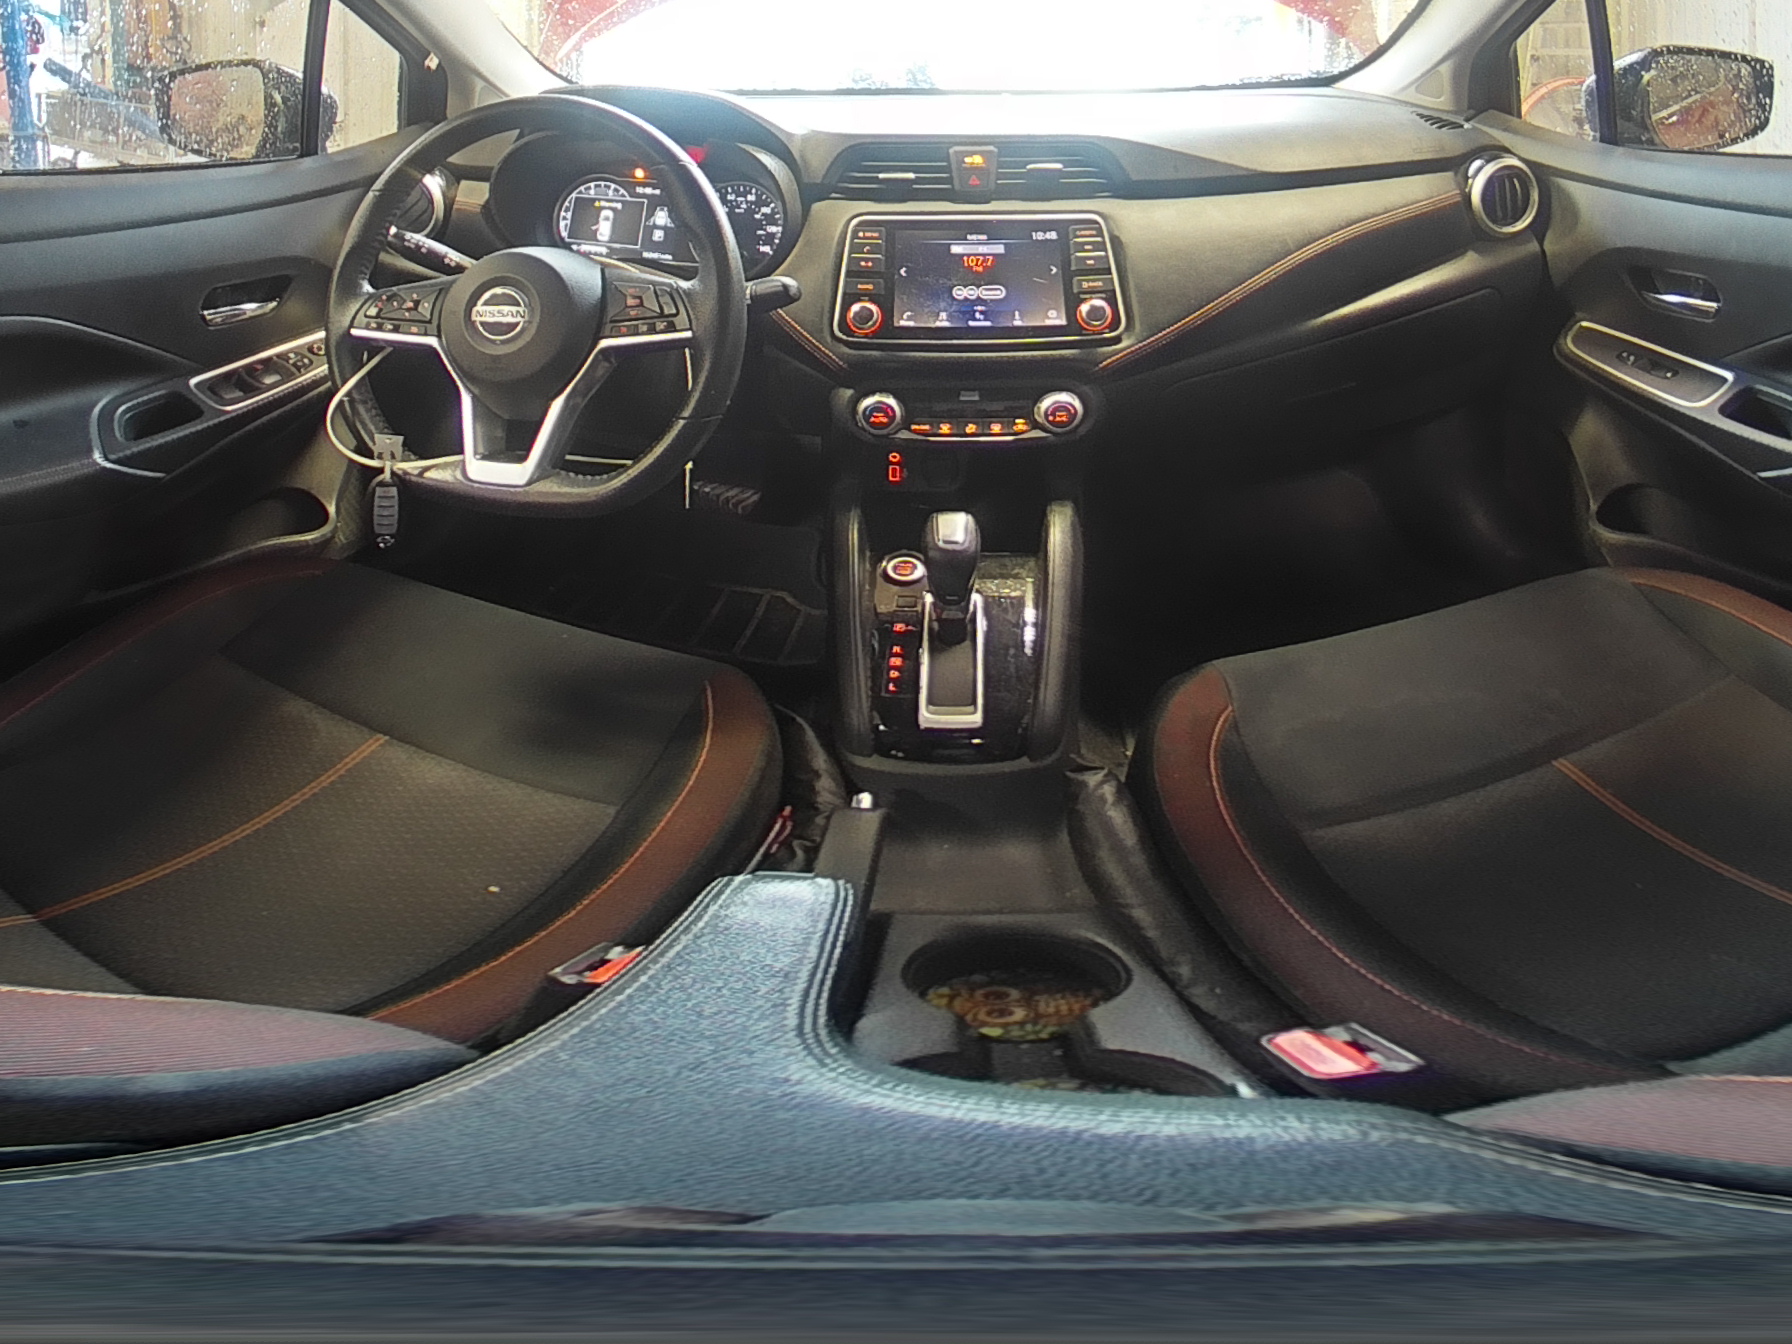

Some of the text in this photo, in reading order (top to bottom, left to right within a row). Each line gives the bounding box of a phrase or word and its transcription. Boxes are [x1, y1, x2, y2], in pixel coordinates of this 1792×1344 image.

[1032, 231, 1058, 240] 10:48
[963, 256, 993, 266] 107.7
[476, 309, 526, 318] NISSAN
